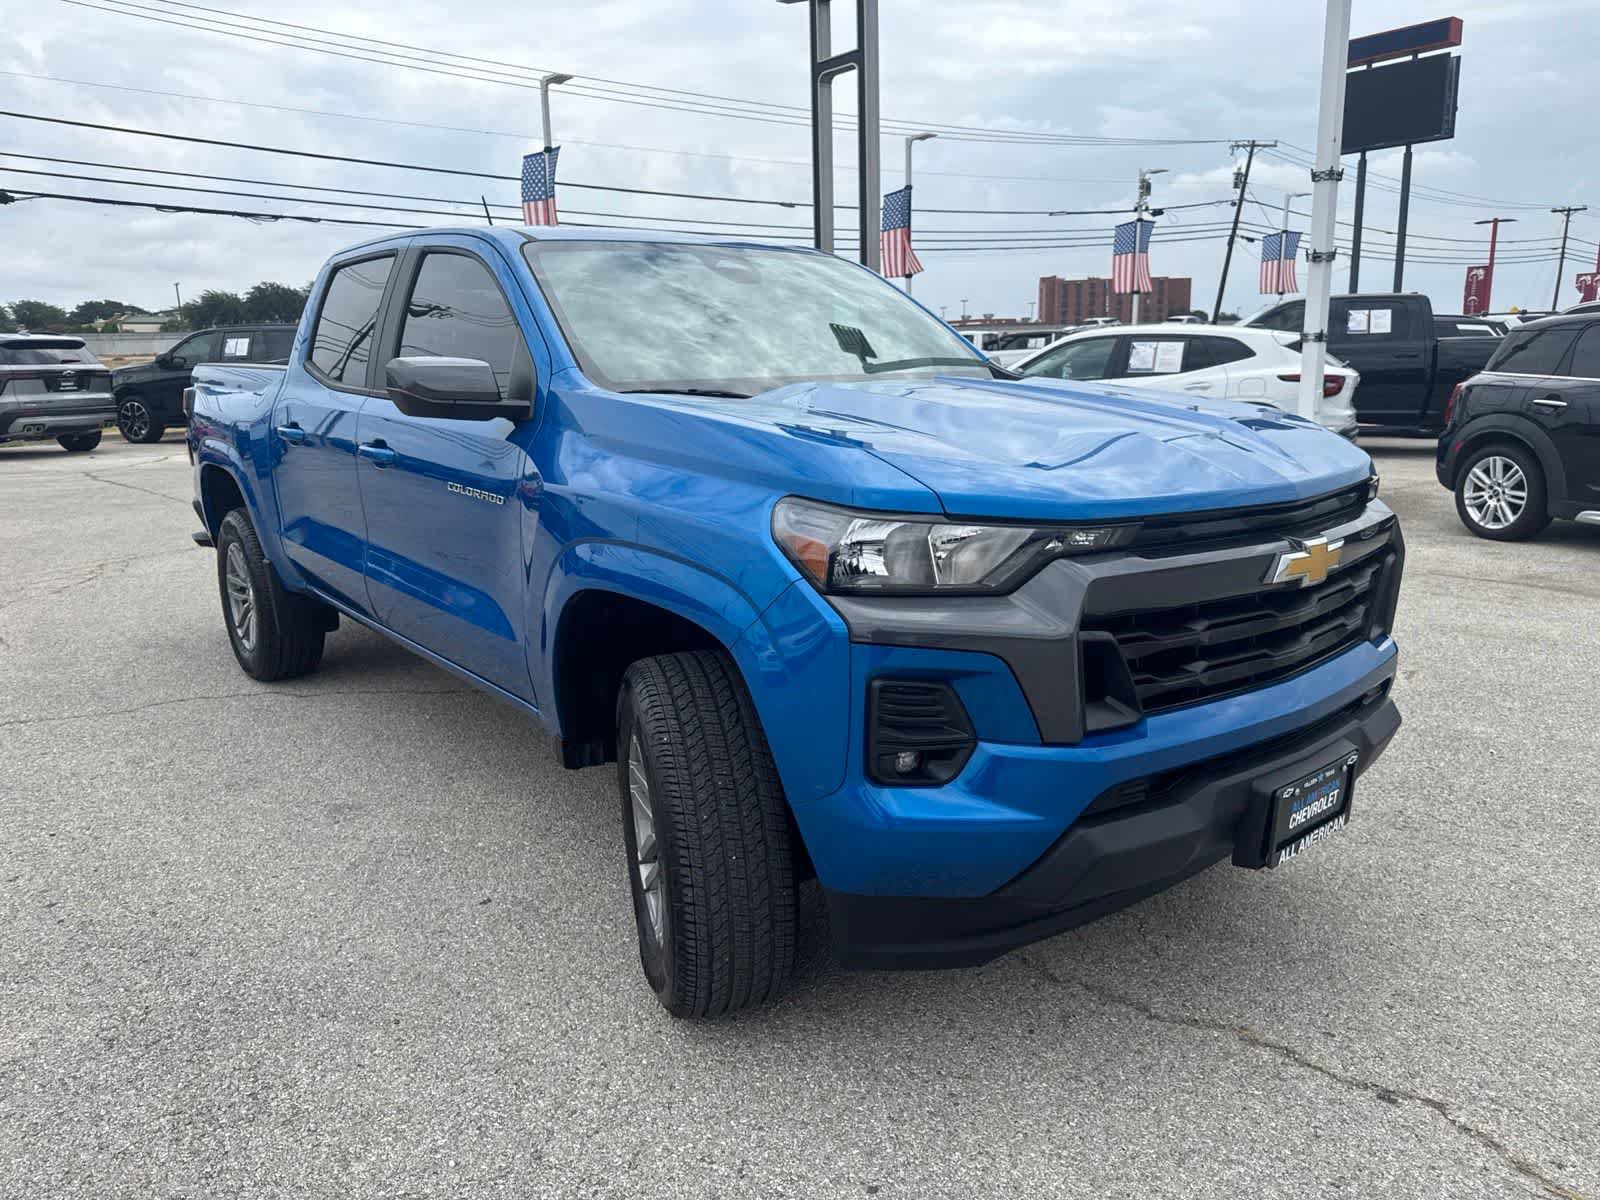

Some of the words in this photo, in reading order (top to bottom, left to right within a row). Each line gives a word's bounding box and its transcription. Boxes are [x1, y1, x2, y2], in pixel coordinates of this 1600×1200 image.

[448, 482, 504, 504] COLORADO
[1289, 789, 1339, 828] CHEVROLET
[1279, 847, 1297, 864] ALL
[1299, 815, 1345, 851] AMERICAN
